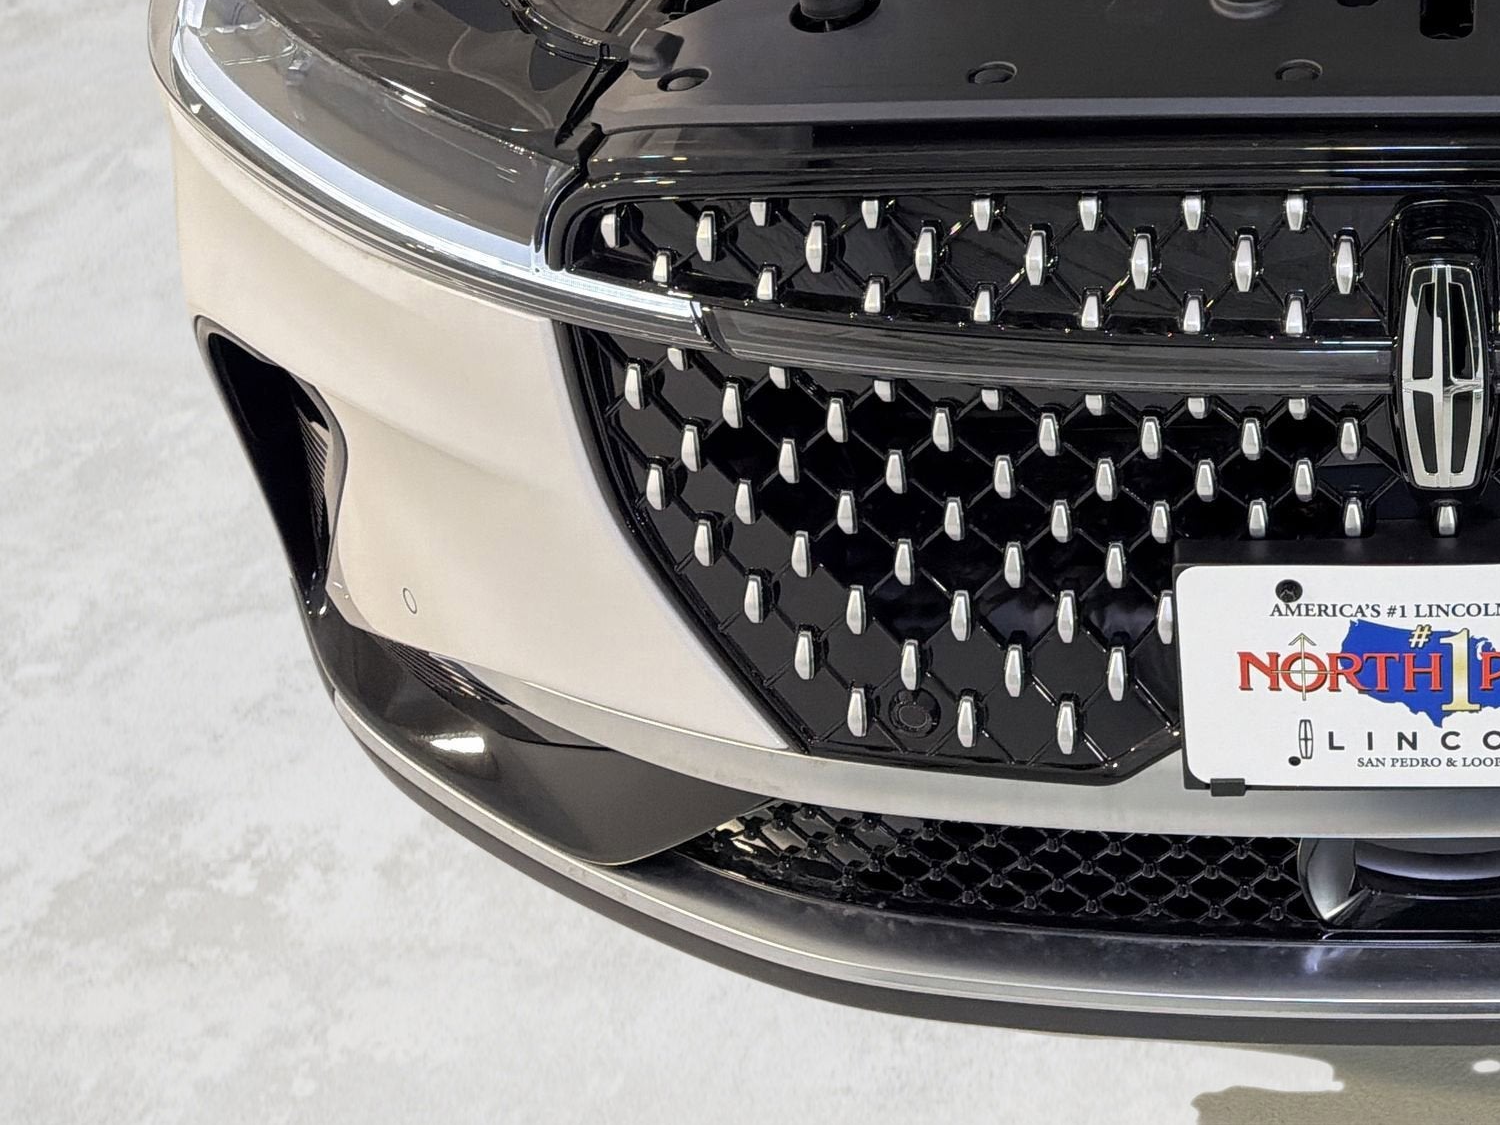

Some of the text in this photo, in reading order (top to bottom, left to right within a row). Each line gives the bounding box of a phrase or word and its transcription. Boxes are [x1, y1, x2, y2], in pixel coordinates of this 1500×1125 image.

[1270, 603, 1382, 619] AMERICA'S
[1387, 605, 1407, 618] #1
[1238, 650, 1442, 691] NORTH
[1357, 757, 1386, 768] SAN
[1391, 756, 1442, 768] PEDRO
[1446, 757, 1457, 767] &
